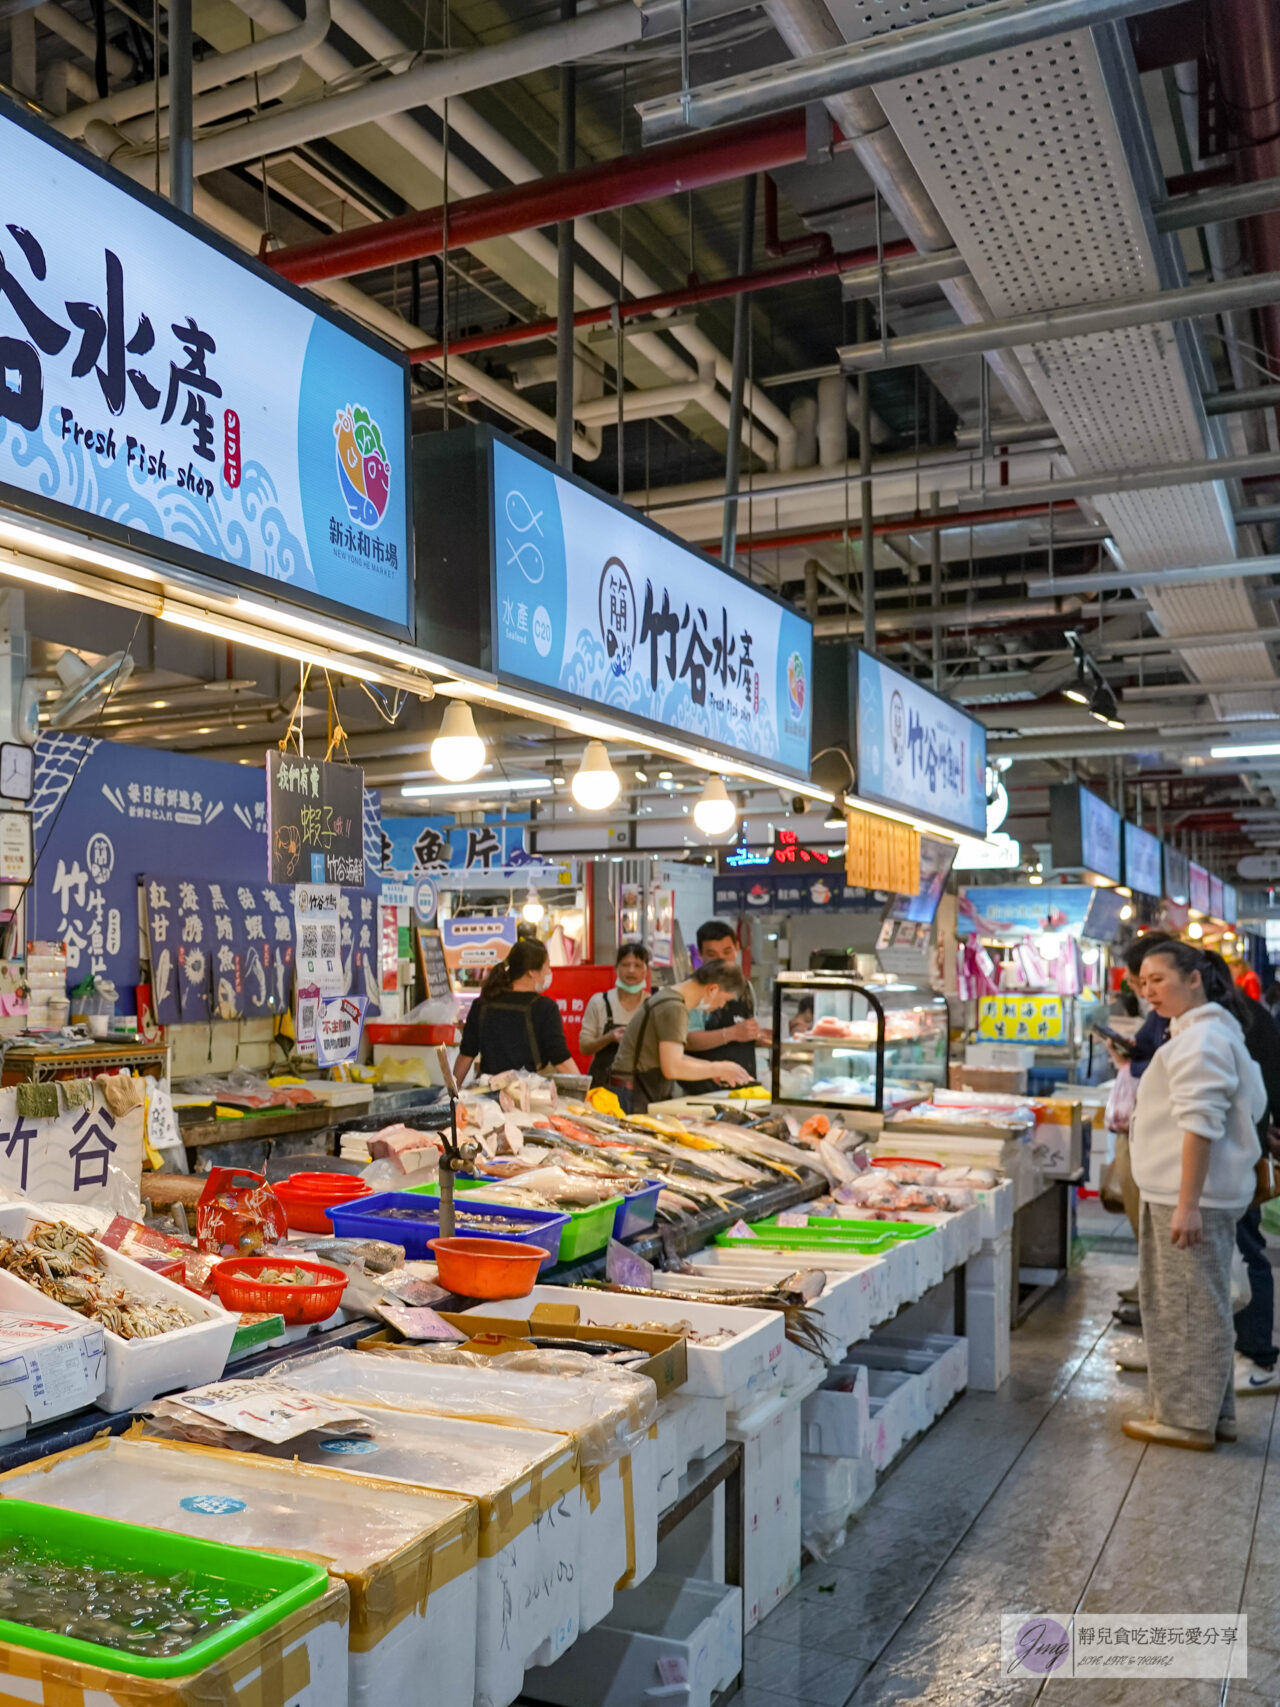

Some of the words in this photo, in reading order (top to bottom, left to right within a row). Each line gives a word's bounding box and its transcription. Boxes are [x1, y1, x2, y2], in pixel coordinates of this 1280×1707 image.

[60, 407, 117, 461] Fresh
[127, 436, 168, 482] Fish
[177, 467, 215, 502] shop
[328, 515, 399, 571] 新永和市場
[502, 594, 529, 632] 水產
[534, 620, 551, 642] C20
[640, 577, 754, 707] 竹谷水產
[52, 859, 89, 969] 竹谷
[149, 881, 171, 942] 紅甘
